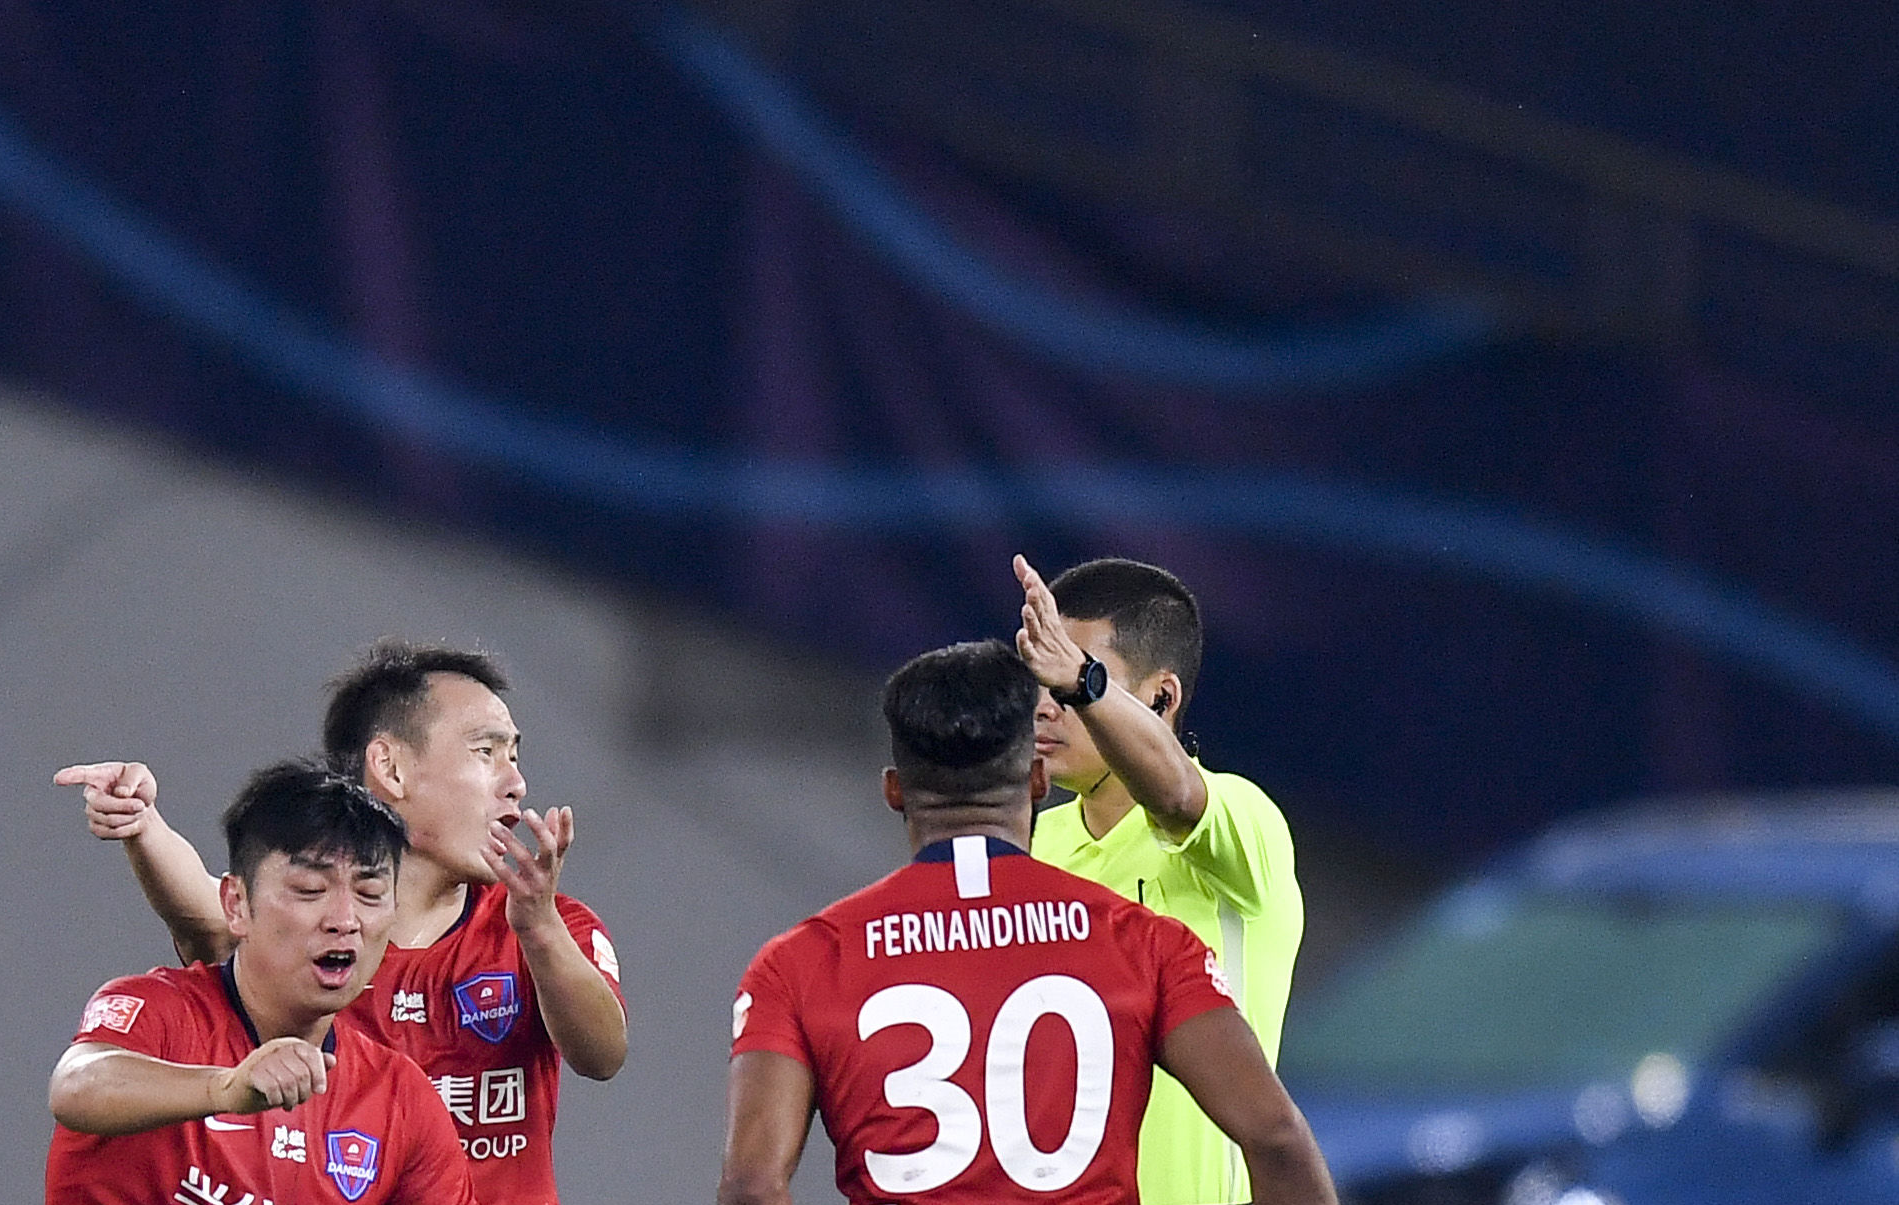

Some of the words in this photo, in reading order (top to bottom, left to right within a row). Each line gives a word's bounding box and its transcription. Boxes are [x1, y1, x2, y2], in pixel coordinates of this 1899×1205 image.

[865, 901, 1091, 959] FERNANDINHO
[461, 1003, 519, 1026] DANGDAI
[857, 973, 1115, 1194] 30
[327, 1161, 378, 1182] DANGDAI
